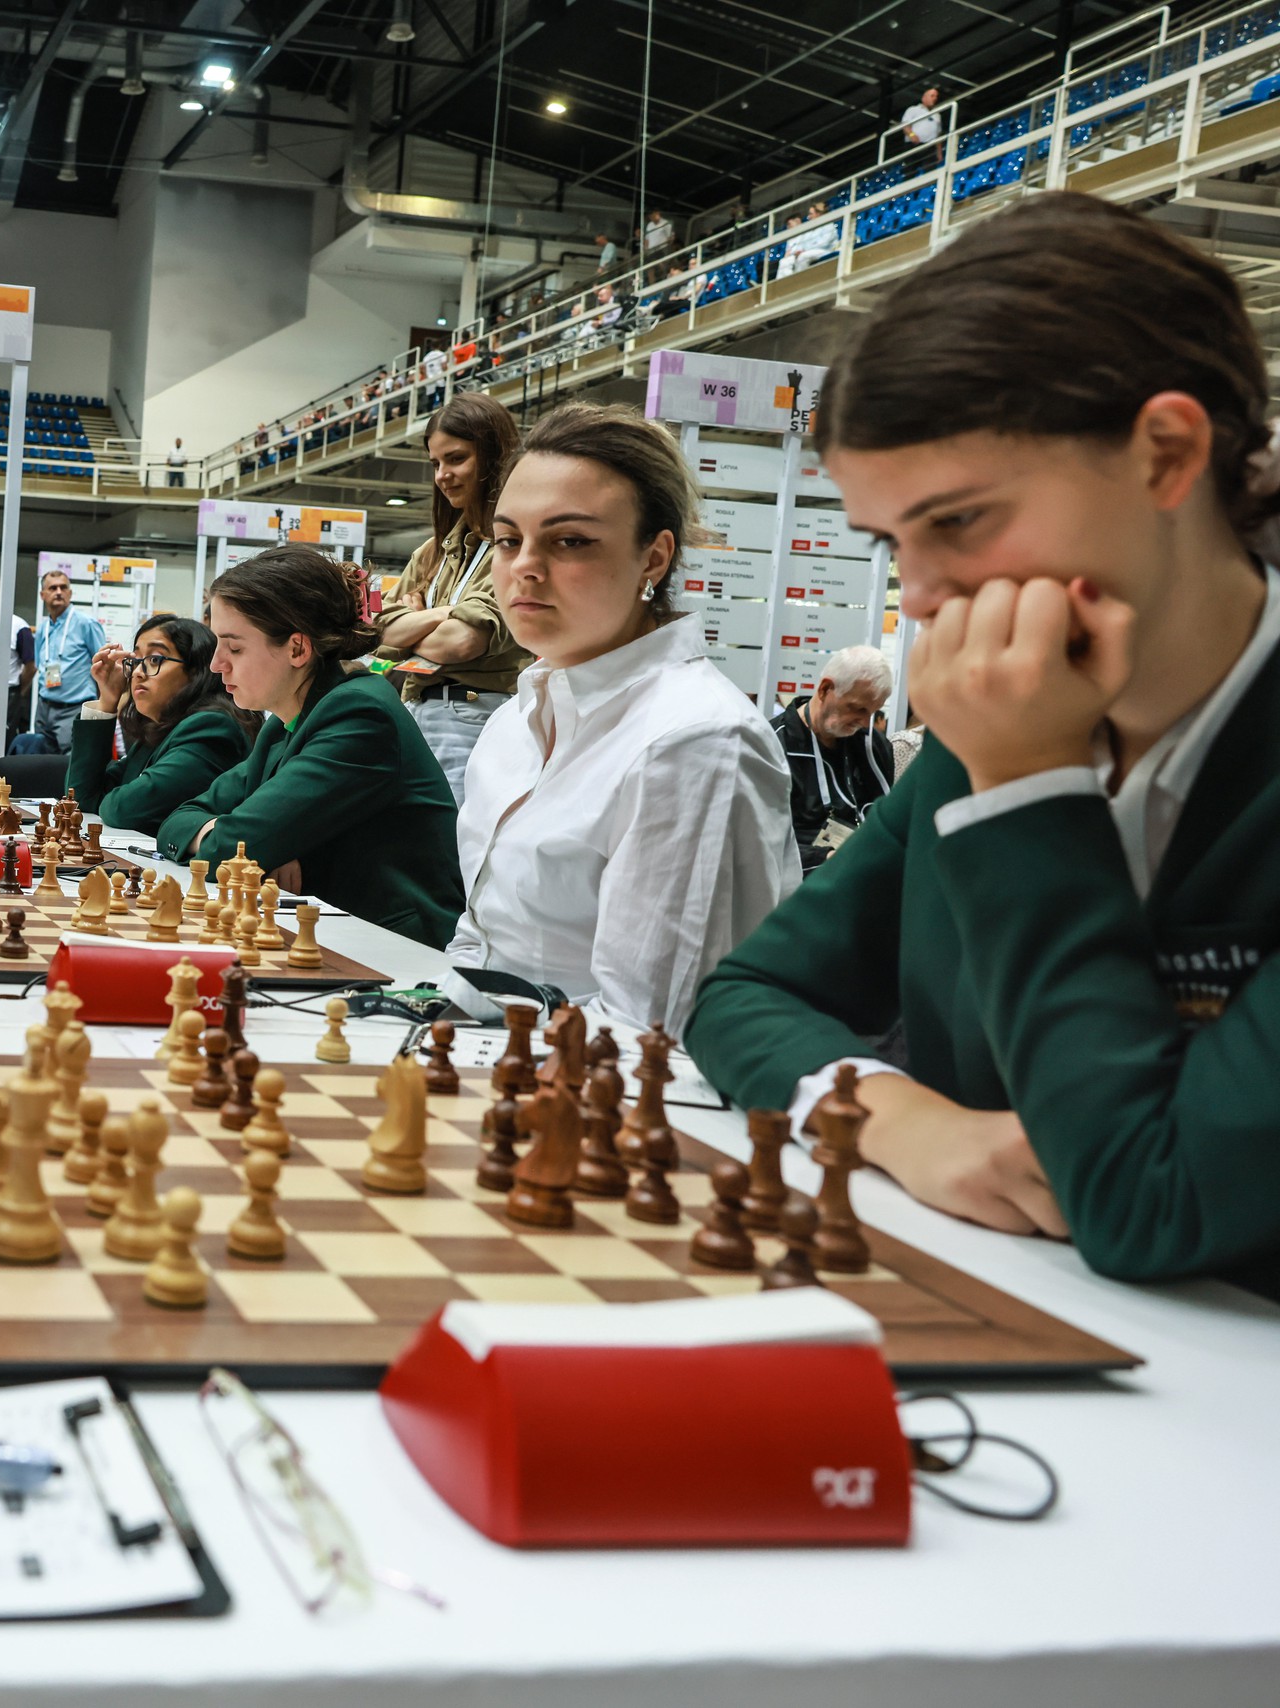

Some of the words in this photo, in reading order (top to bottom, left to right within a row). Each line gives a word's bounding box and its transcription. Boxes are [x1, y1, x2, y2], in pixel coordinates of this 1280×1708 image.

[703, 383, 718, 396] W
[720, 385, 736, 398] 36
[790, 420, 810, 433] ST
